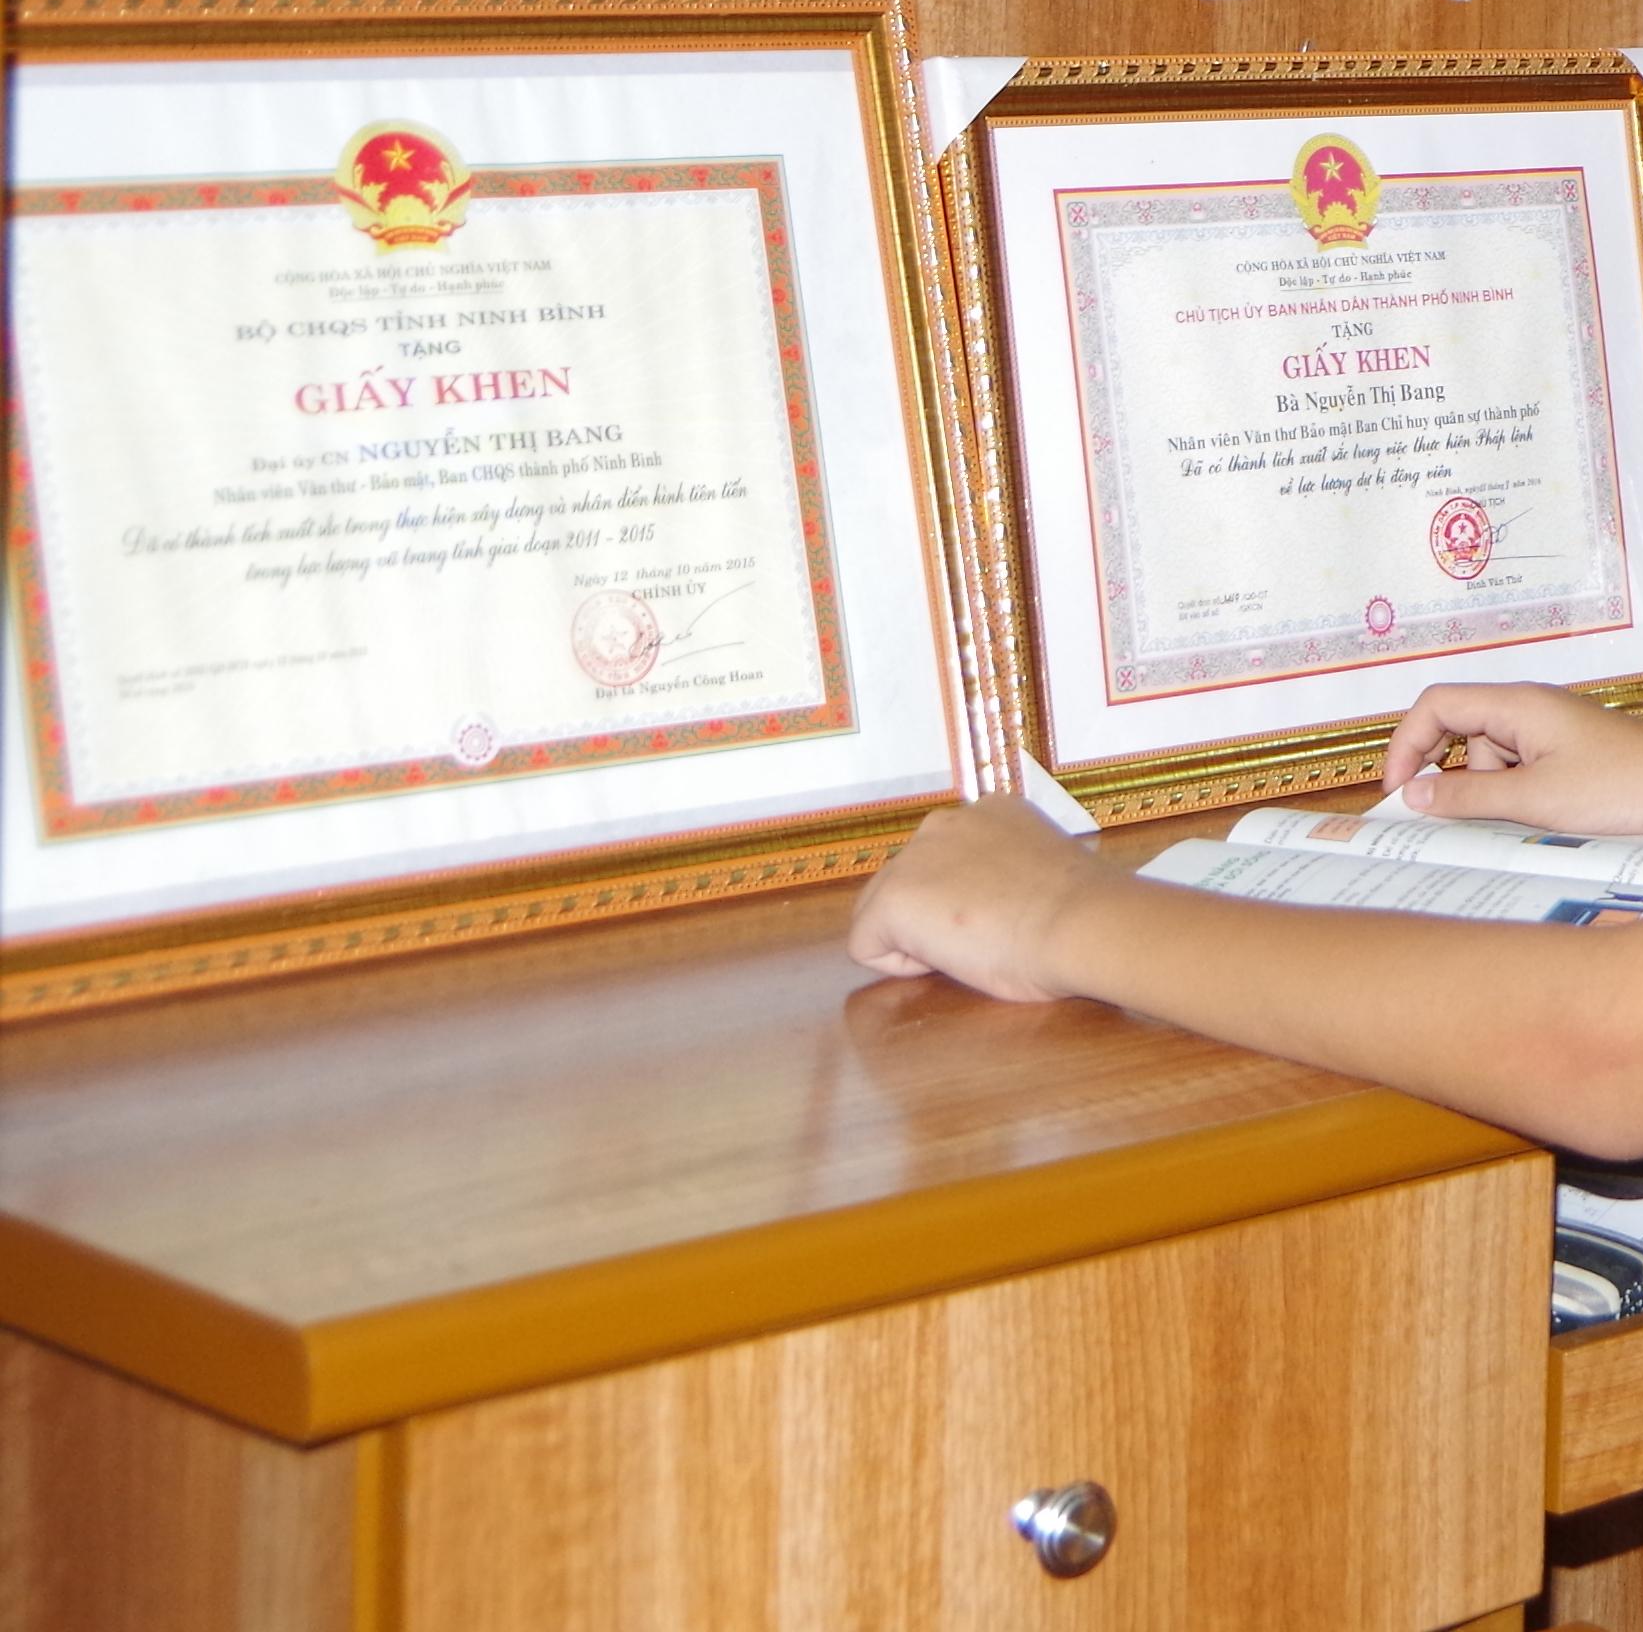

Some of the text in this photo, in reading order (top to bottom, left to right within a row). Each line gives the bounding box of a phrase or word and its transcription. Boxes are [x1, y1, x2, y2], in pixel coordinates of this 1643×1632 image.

[1235, 260, 1268, 276] CỘNG
[1360, 251, 1395, 266] NGHĨA
[1396, 249, 1422, 264] VIỆT
[1423, 249, 1447, 262] NAM
[1175, 286, 1515, 326] CHỦ TỊCH ỦY BAN NHÂN DÂN THÀNH PHỐ NINH BÌNH
[287, 318, 367, 339] CHQS
[376, 309, 447, 332] TỈNH
[457, 307, 528, 328] NINH
[538, 303, 607, 323] BÌNH
[1331, 322, 1374, 341] TẶNG
[398, 340, 462, 359] TẶNG
[1283, 342, 1431, 380] GIẤY KHEN
[294, 365, 572, 416] GIẤY KHEN
[1276, 383, 1446, 414] Bà Nguyễn Thị Bang
[1167, 400, 1541, 453] Nhân viên Văn thư Bảo mật Ban Chỉ huy quân sự thành phố
[358, 427, 482, 464] NGUYỄN
[488, 430, 537, 454] THỊ
[547, 424, 624, 449] BANG
[439, 466, 468, 485] Ban
[472, 462, 515, 483] CHQS
[518, 459, 560, 479] thành
[562, 455, 589, 478] phố
[593, 452, 627, 472] Ninh
[630, 450, 663, 468] Bình
[1208, 456, 1223, 473] có
[1228, 451, 1267, 473] thành
[564, 529, 600, 551] 2011
[618, 523, 655, 545] 2015
[613, 569, 629, 582] 12
[636, 564, 674, 581] tháng
[726, 556, 756, 570] 2015
[631, 582, 682, 601] CHÍNH
[639, 676, 690, 696] Nguyễn
[692, 672, 726, 689] Công
[729, 668, 764, 684] Hoan
